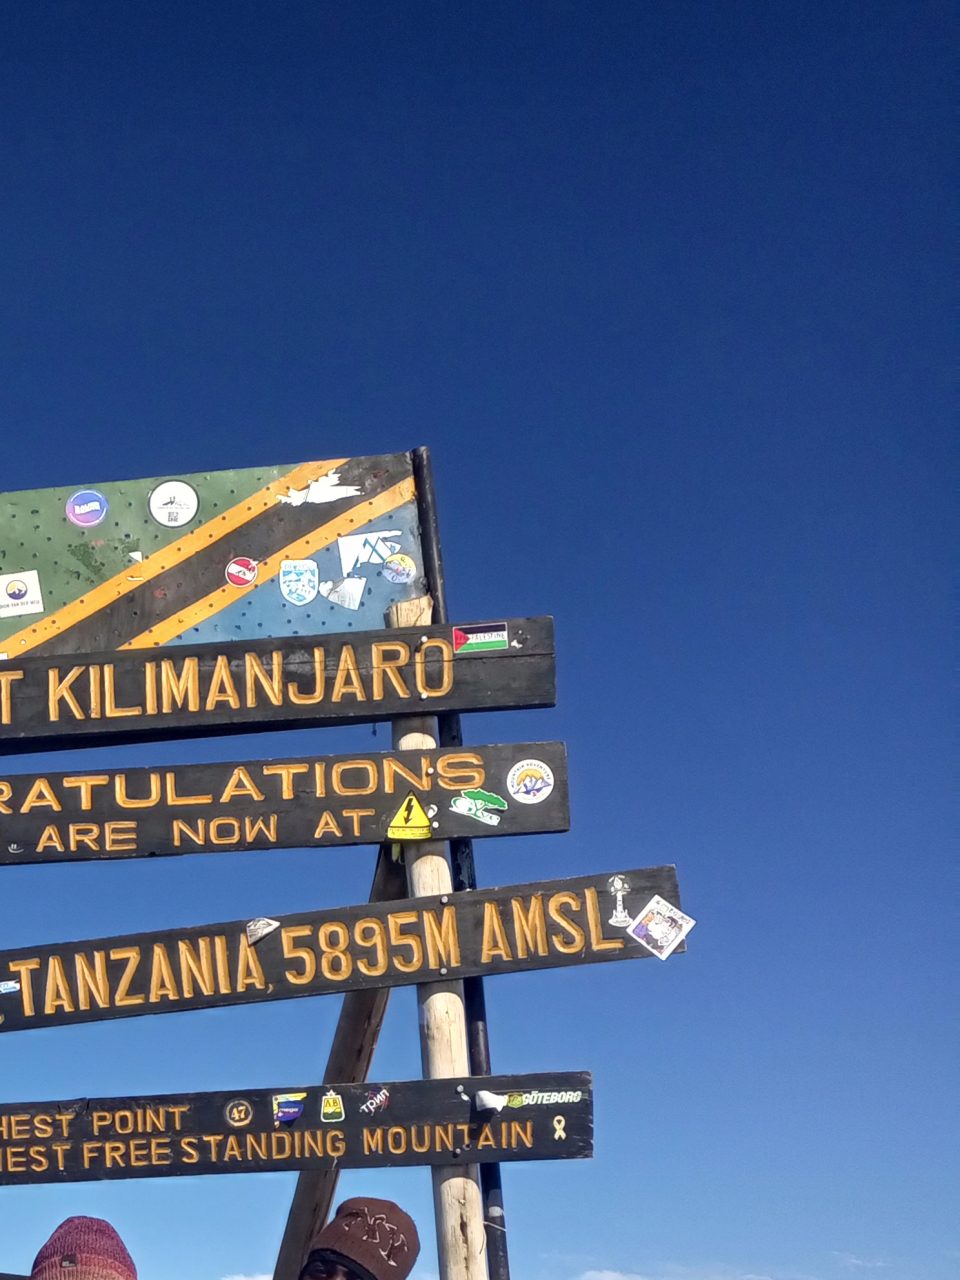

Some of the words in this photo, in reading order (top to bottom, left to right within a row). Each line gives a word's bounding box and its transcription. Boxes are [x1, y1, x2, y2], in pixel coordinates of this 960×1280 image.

[471, 631, 505, 641] PALESTINE
[49, 637, 453, 721] KILIMANJARO
[36, 822, 138, 852] ARE
[173, 814, 278, 847] NOW
[314, 809, 375, 838] AT
[9, 934, 273, 1016] TANZANIA,
[280, 905, 461, 985] 5895M
[481, 886, 625, 963] AMSL
[231, 1105, 246, 1121] 47
[523, 1090, 582, 1104] GÖTEBORG
[92, 1105, 189, 1136] POINT
[83, 1137, 174, 1168] FREE
[181, 1129, 346, 1164] STANDING
[363, 1120, 533, 1155] MOUNTAIN
